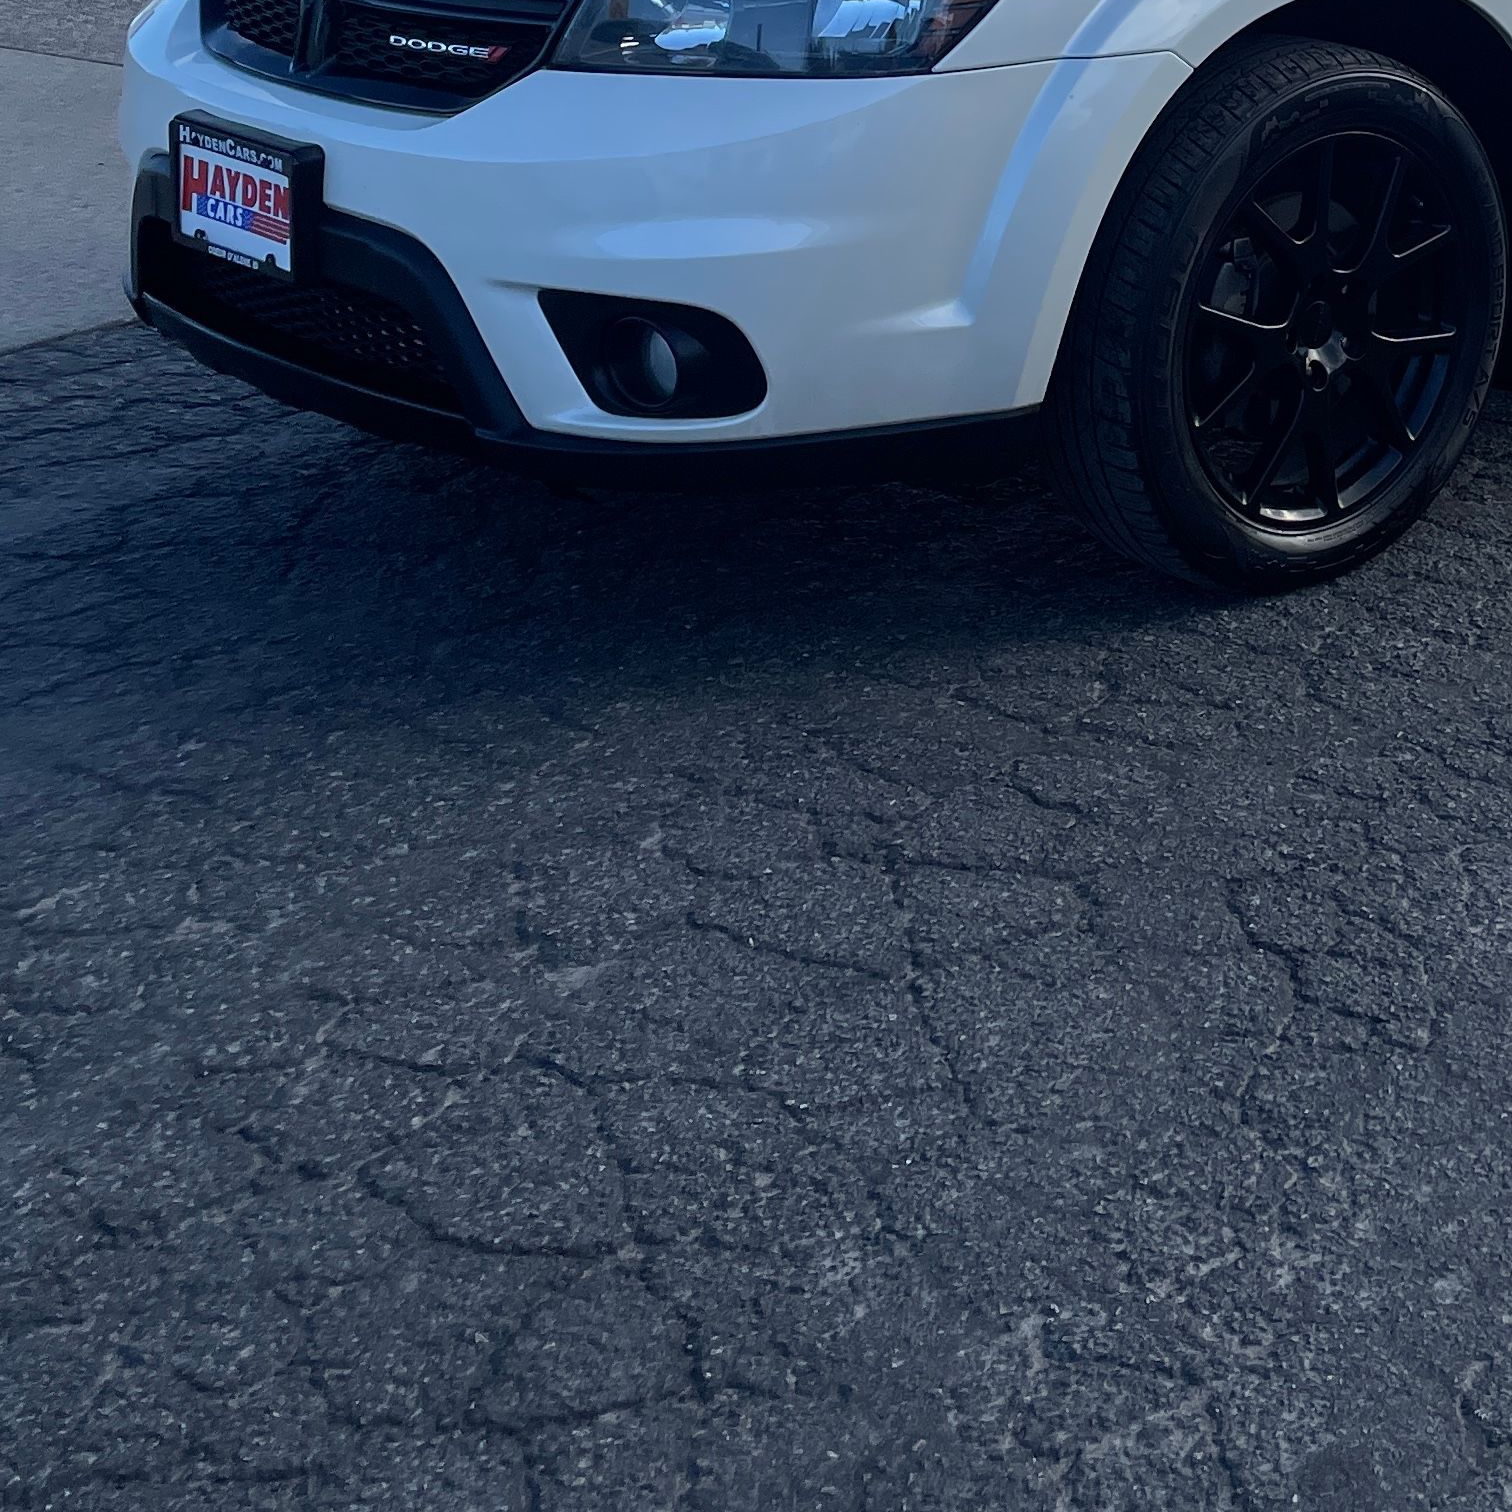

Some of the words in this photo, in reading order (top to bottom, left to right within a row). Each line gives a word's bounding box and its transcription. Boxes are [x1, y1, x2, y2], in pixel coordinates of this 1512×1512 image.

[390, 35, 490, 59] DODGE
[182, 155, 290, 219] HAYDEN
[207, 198, 243, 227] CARS
